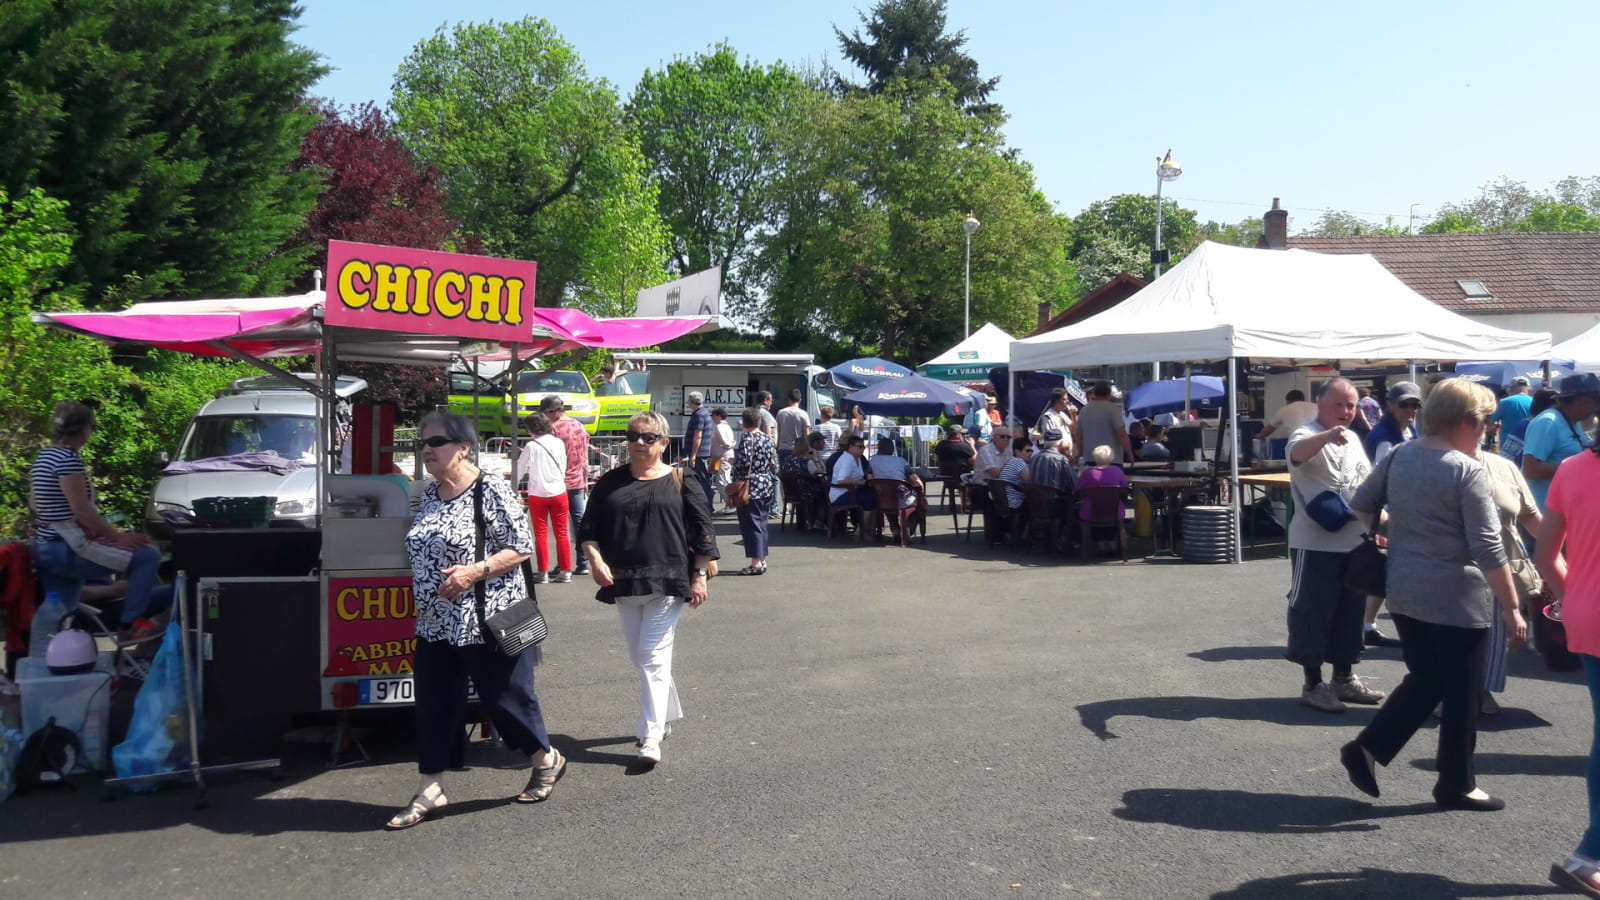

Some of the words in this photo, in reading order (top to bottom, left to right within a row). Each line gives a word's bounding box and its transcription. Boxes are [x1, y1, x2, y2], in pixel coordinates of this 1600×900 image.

[338, 258, 525, 326] CHICHI
[947, 368, 958, 376] LA
[960, 367, 983, 376] VRAIE
[377, 680, 413, 701] 970
